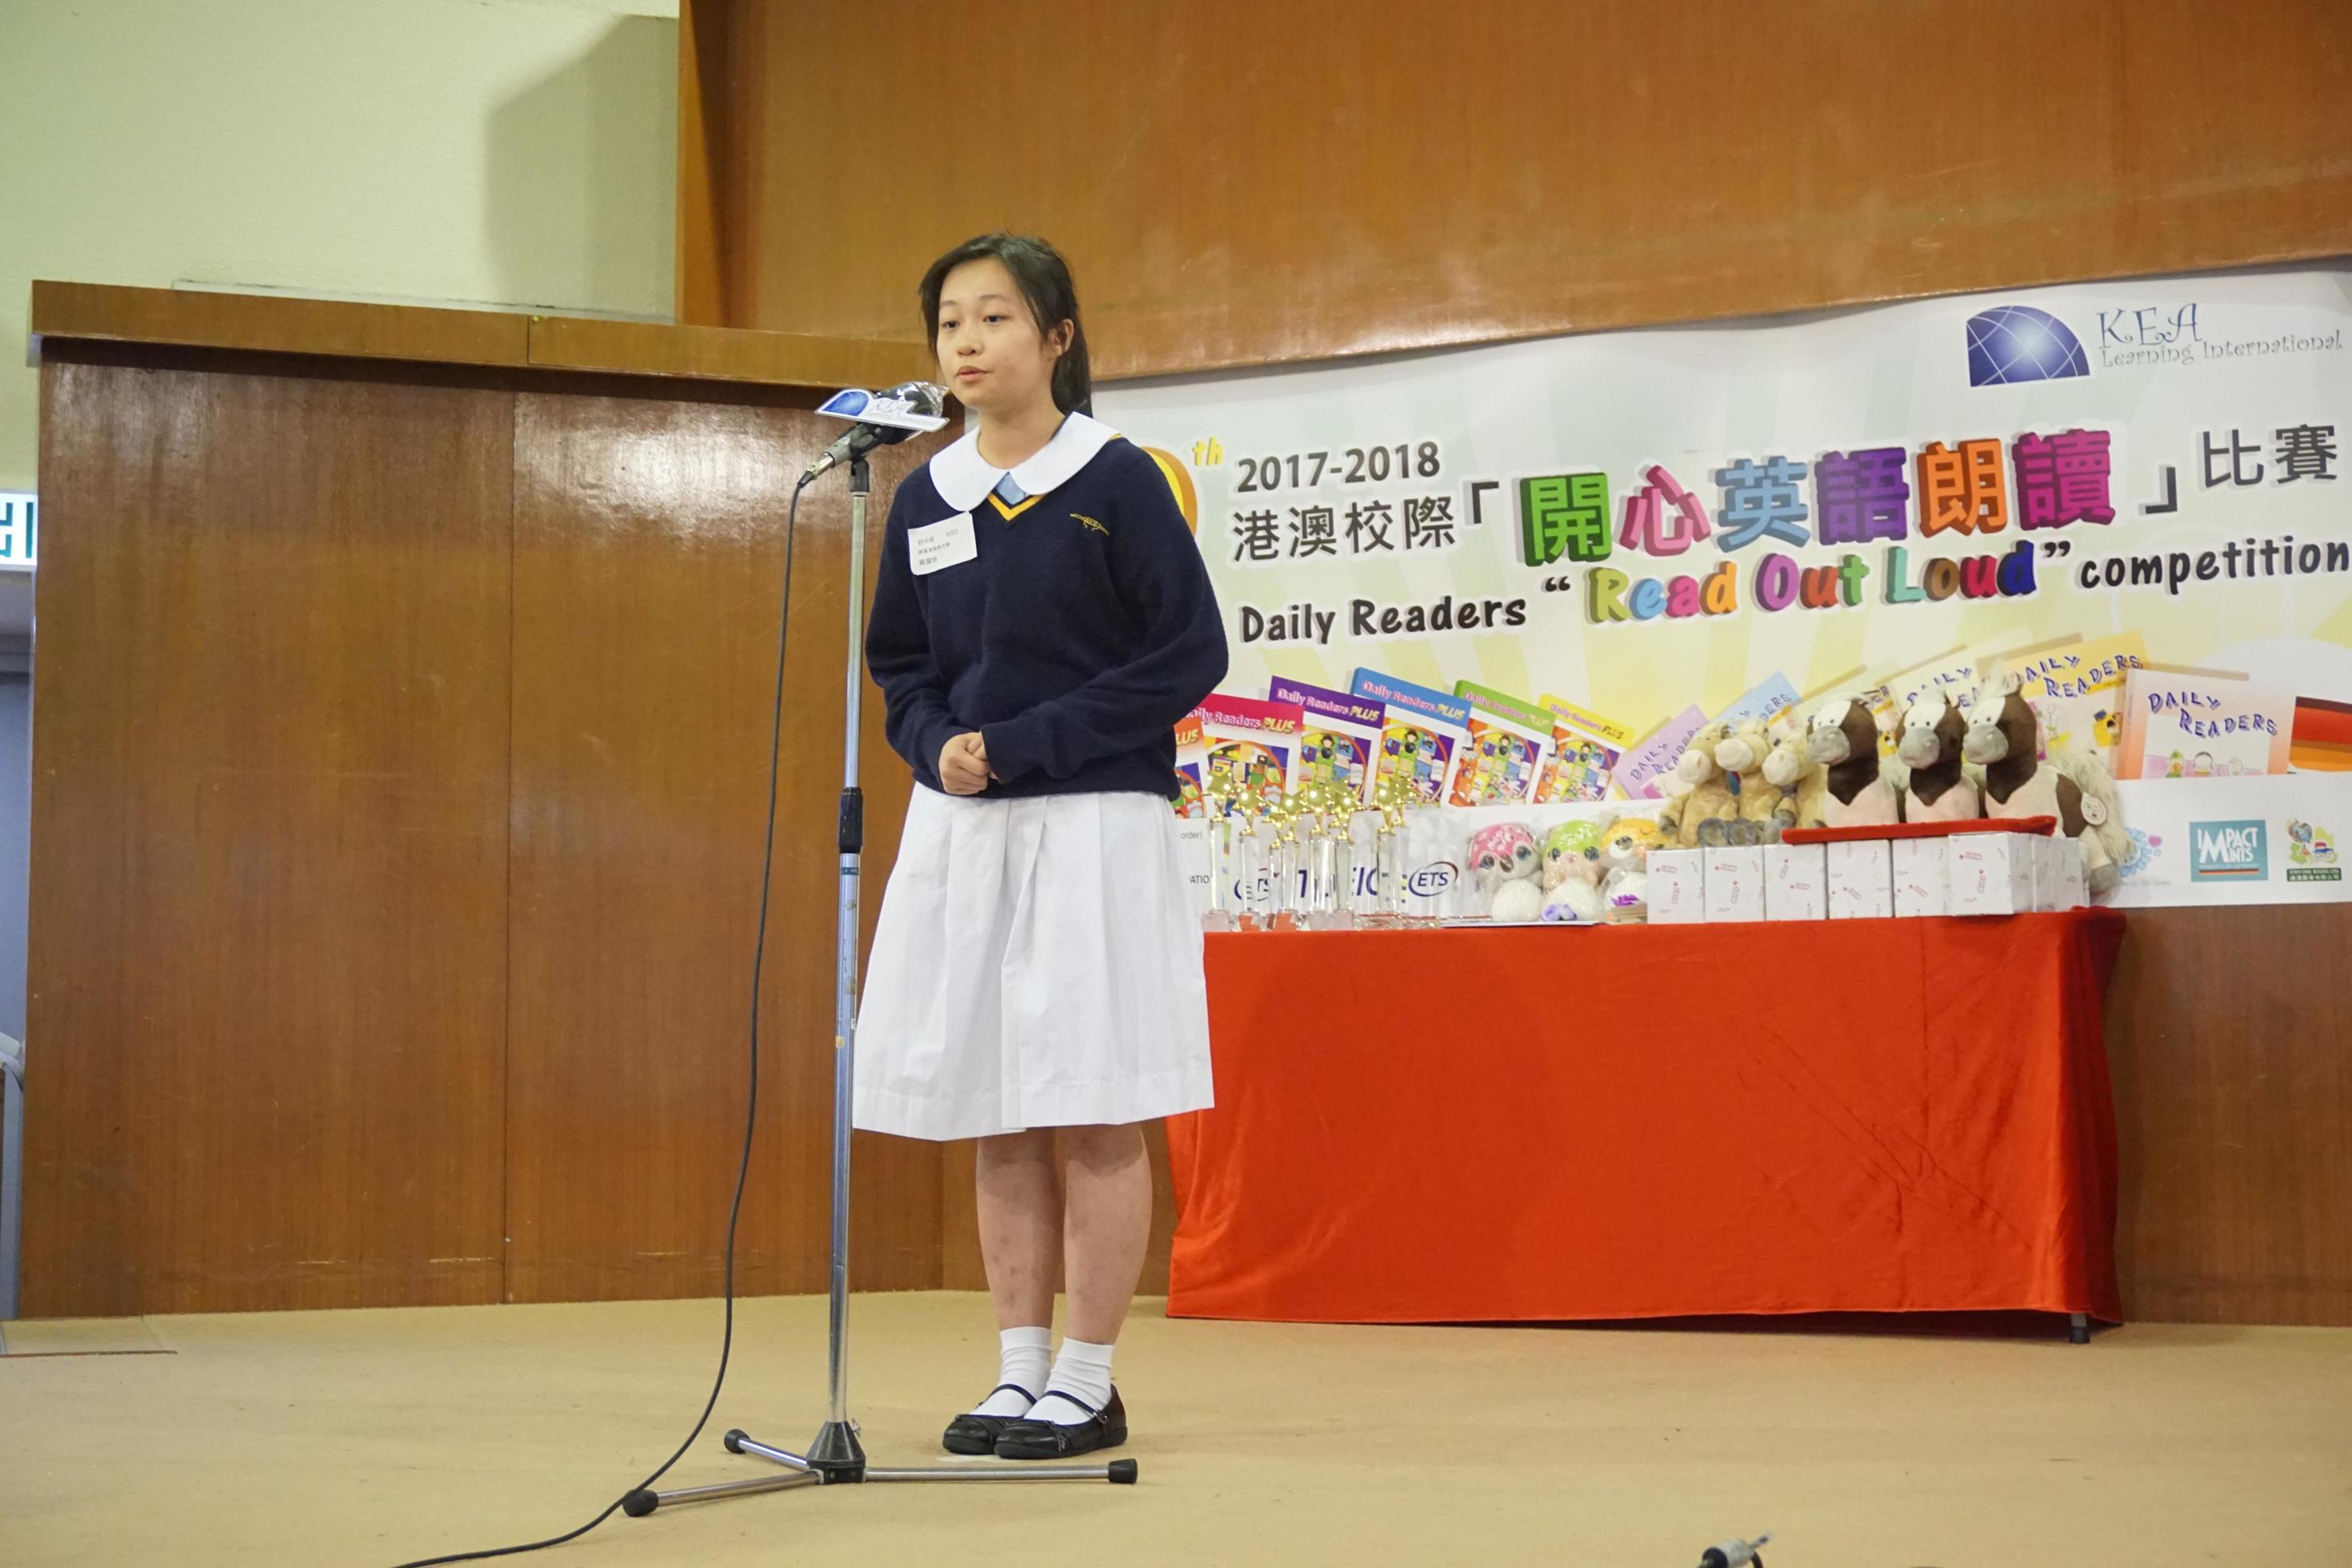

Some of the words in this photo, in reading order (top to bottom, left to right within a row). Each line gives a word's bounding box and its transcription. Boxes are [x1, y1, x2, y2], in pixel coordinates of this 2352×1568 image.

[2096, 303, 2202, 349] KEA
[2100, 344, 2195, 368] Learning
[2202, 329, 2343, 359] International
[1237, 441, 1441, 493] 2017-2018
[1241, 603, 1337, 645] Daily
[1350, 596, 1526, 636] Readers
[1755, 552, 1870, 611] Out
[2080, 534, 2349, 595] competition
[2025, 654, 2080, 682] AILY
[2043, 654, 2143, 698] READERS
[1278, 687, 1306, 706] Daily
[1306, 695, 1350, 716] Readers
[1349, 704, 1380, 722] PLUS
[1362, 678, 1393, 700] Daily
[1392, 690, 1435, 711] Readers
[1435, 702, 1466, 721] PLUS
[1465, 690, 1490, 708] Daily
[1550, 702, 1571, 720] Daily
[2148, 690, 2221, 714] DAILY
[1176, 728, 1199, 745] LUS
[1186, 706, 1212, 726] aily
[1214, 711, 1262, 730] Readers
[1262, 717, 1296, 734] PLUS
[2179, 707, 2278, 738] READERS
[1630, 742, 1668, 781] DAILY
[1418, 871, 1449, 888] ETS
